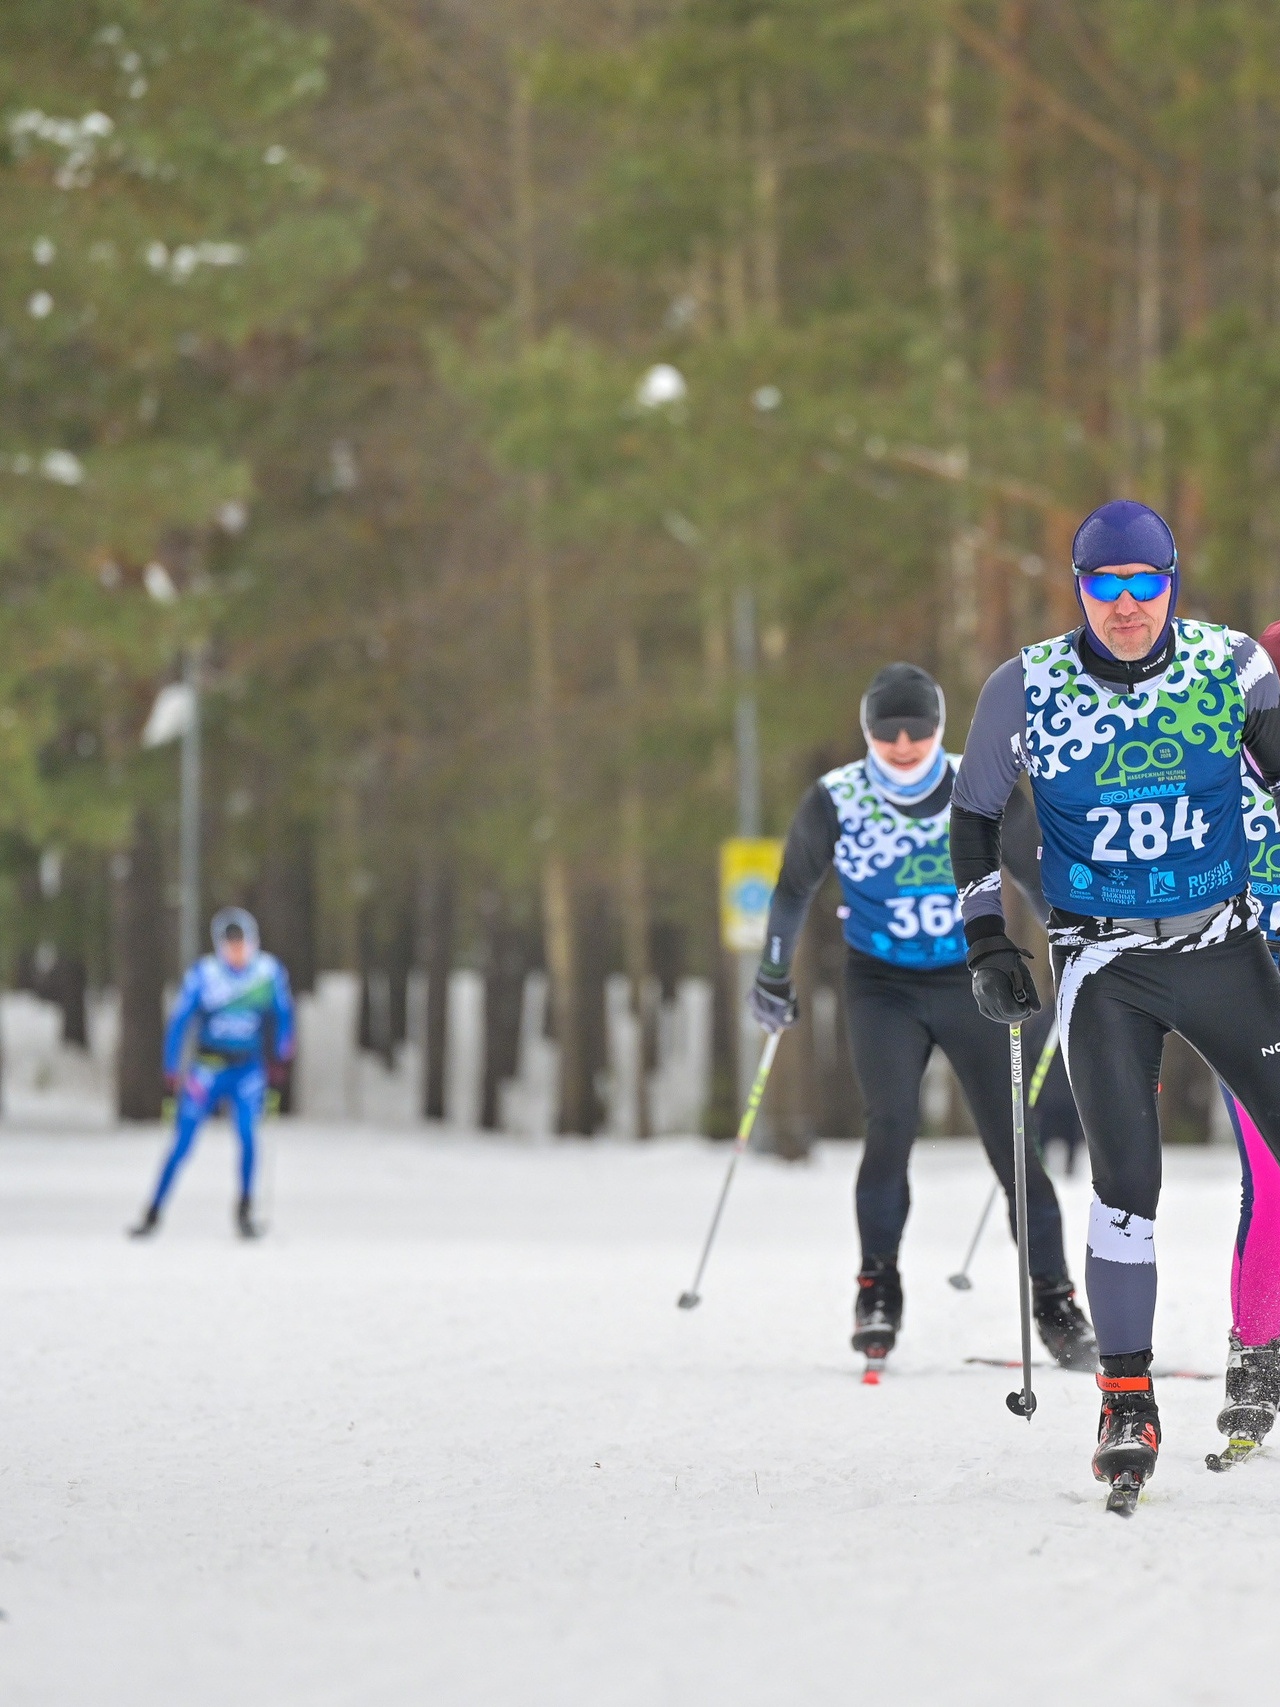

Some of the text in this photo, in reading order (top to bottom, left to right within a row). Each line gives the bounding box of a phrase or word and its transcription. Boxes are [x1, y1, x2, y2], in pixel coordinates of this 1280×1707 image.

[1095, 737, 1184, 787] 400
[1127, 771, 1165, 780] НАБЕРЕЖНЫЕ
[1128, 782, 1186, 799] KAMAZ
[1086, 796, 1210, 862] 284
[1188, 860, 1231, 888] RUSSIA
